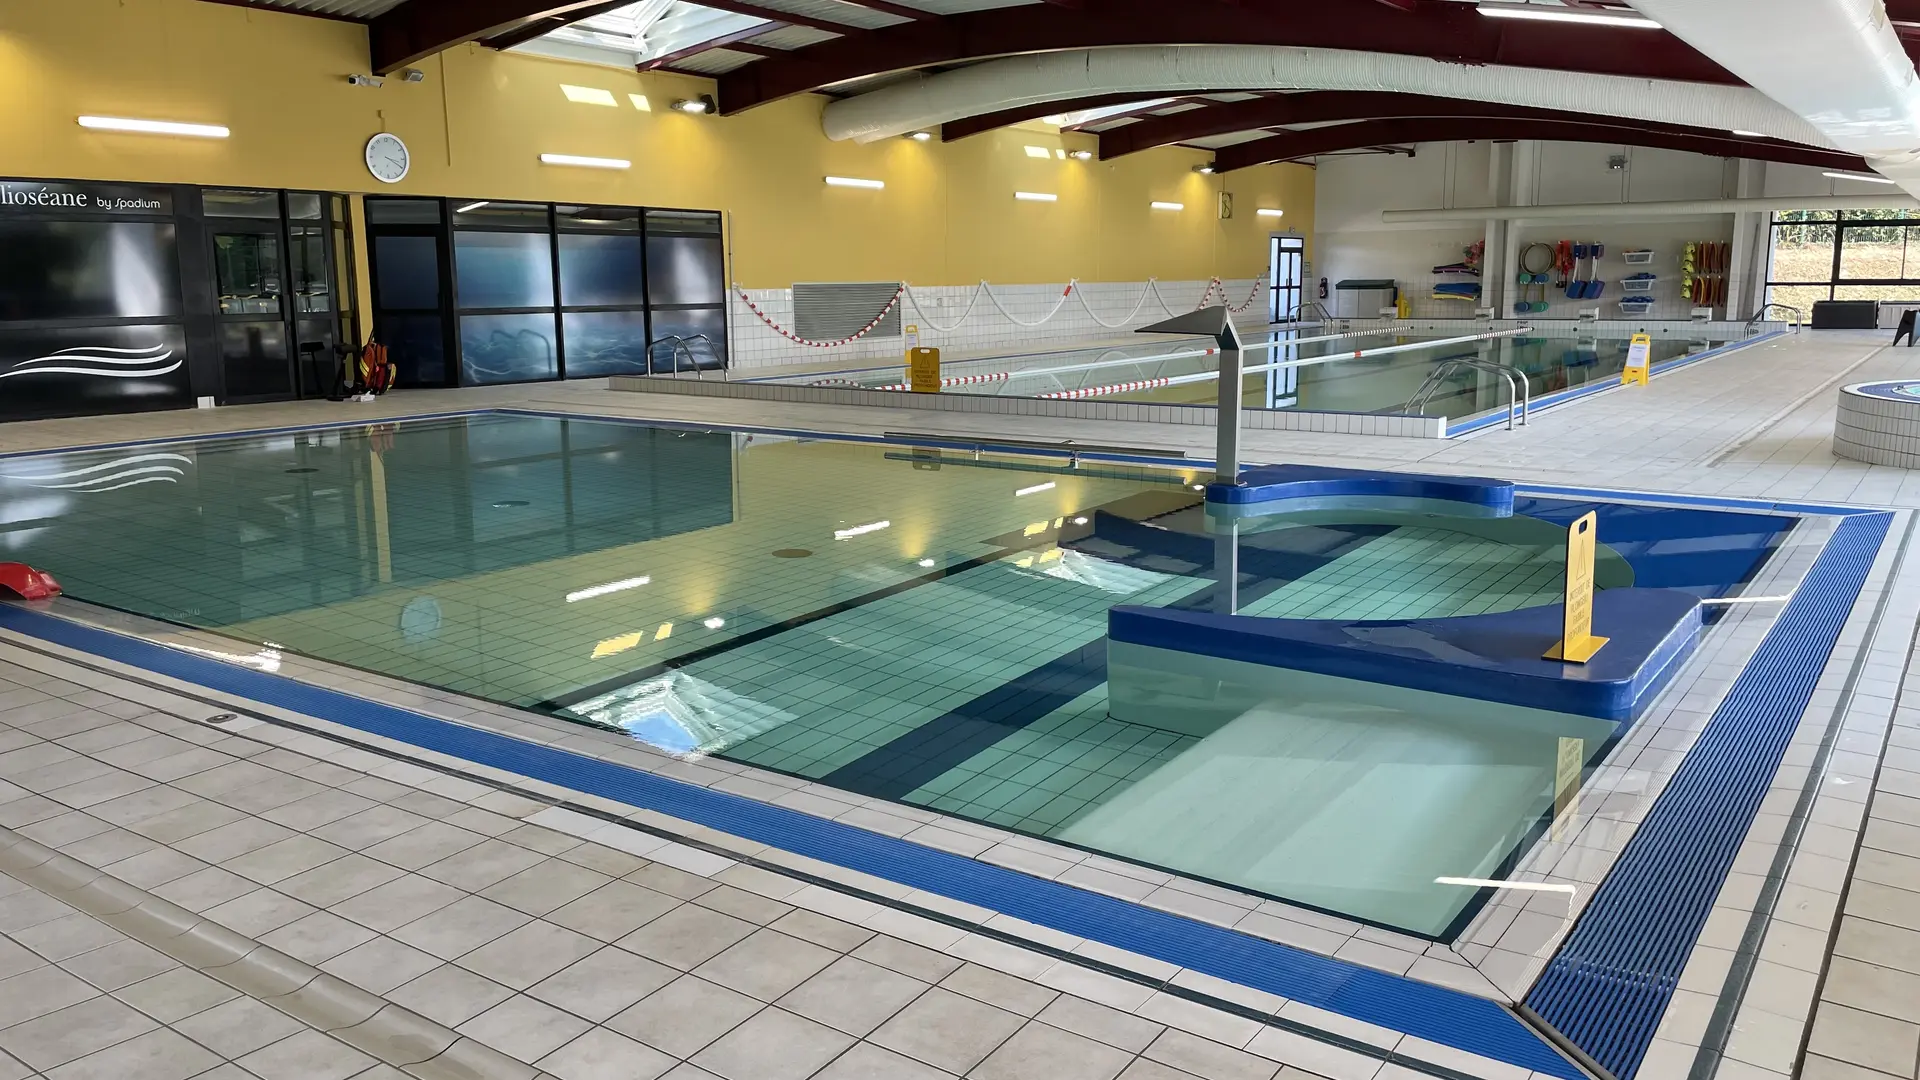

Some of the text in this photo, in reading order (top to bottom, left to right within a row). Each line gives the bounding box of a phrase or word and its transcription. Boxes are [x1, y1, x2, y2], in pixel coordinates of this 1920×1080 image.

[1, 184, 160, 210] lioséane by Spadium
